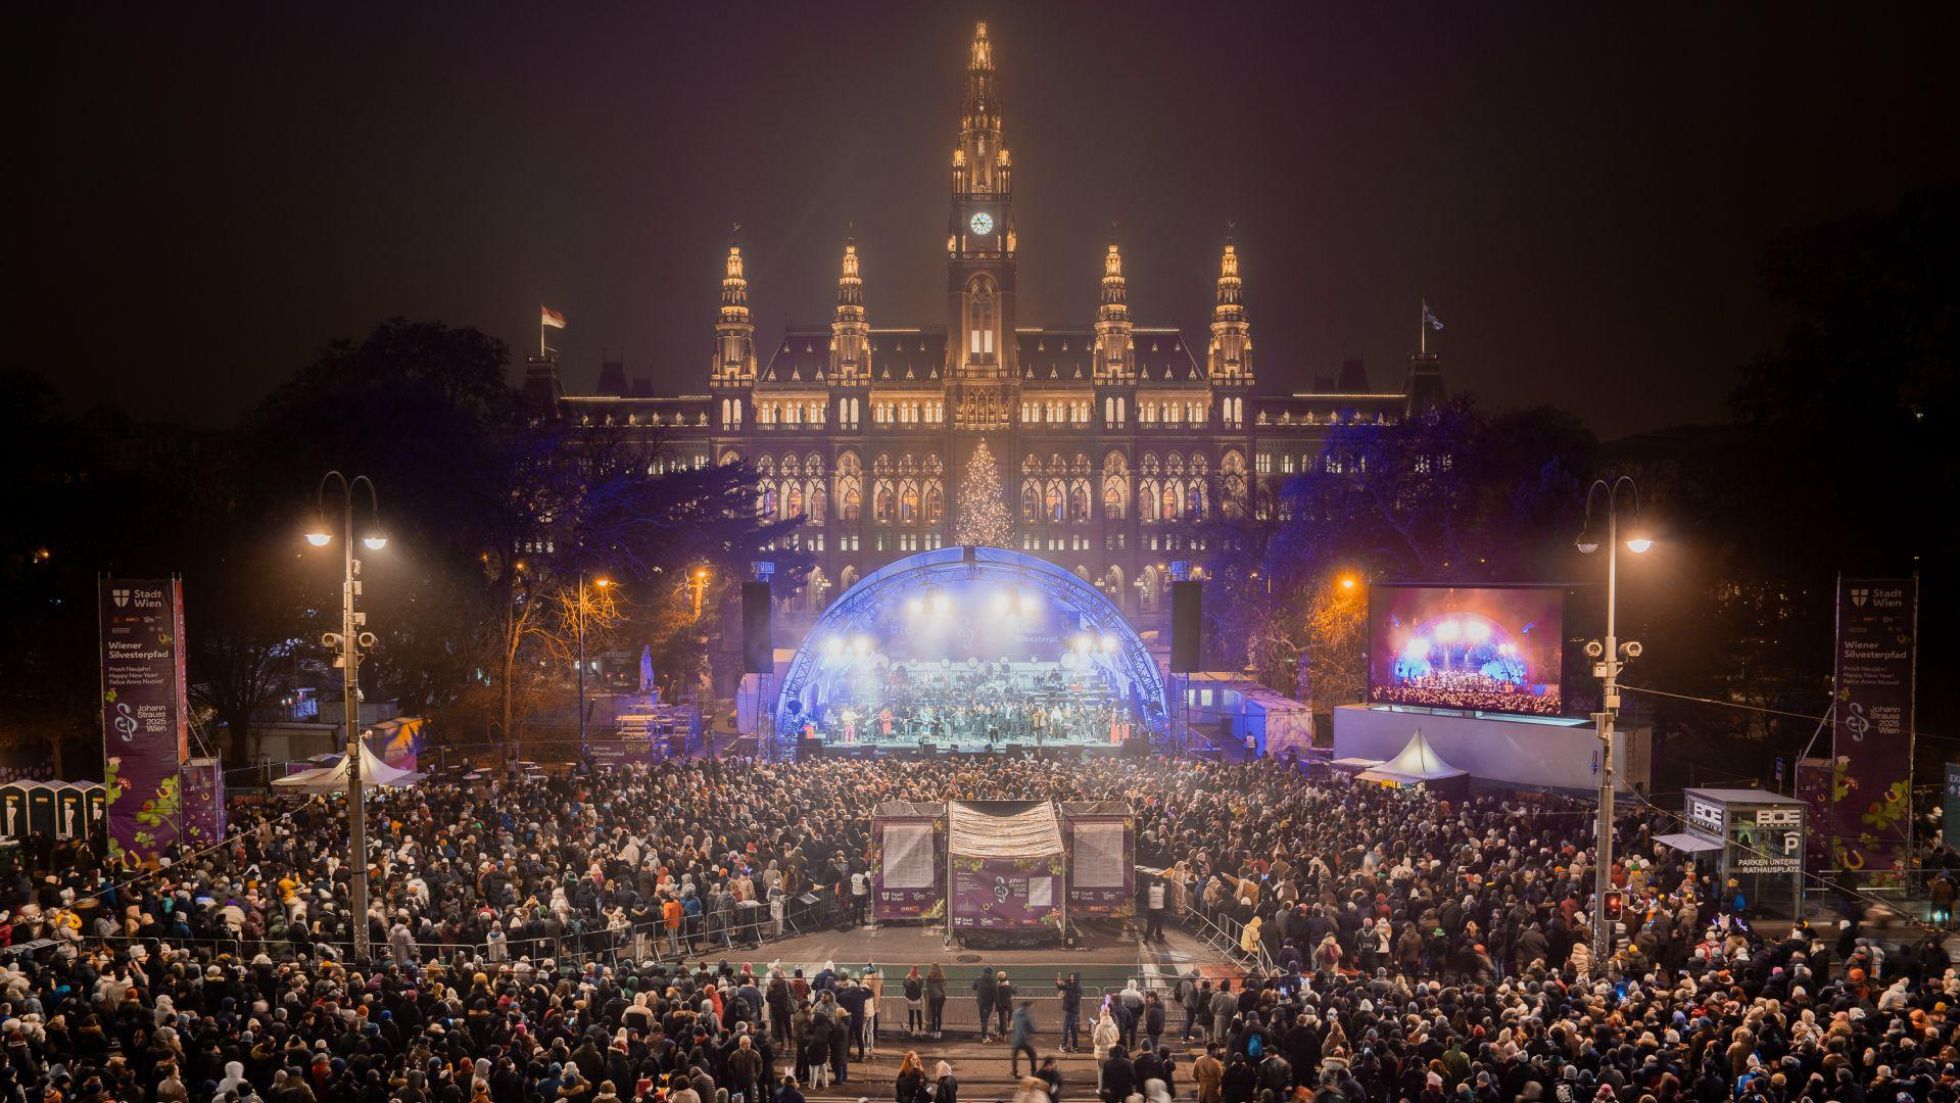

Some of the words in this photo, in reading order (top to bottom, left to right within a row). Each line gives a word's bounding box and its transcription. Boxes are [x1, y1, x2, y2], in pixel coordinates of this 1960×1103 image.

[134, 589, 162, 599] Stadt
[1872, 588, 1902, 598] Stadt
[134, 599, 162, 608] Wien
[1872, 599, 1902, 607] Wien
[108, 641, 142, 650] Wiener
[1844, 641, 1879, 649] Wiener
[108, 650, 169, 661] Silvesterpfad
[1844, 650, 1907, 660] Silvesterpfad
[137, 704, 166, 712] Johann
[1870, 705, 1900, 713] Johann
[137, 711, 166, 719] Strauss
[1870, 712, 1900, 720] Strauss
[1879, 719, 1900, 727] 2025
[146, 725, 167, 733] Wien
[1878, 726, 1900, 734] Wien
[1785, 837, 1799, 855] P
[1769, 858, 1800, 866] UNTERM
